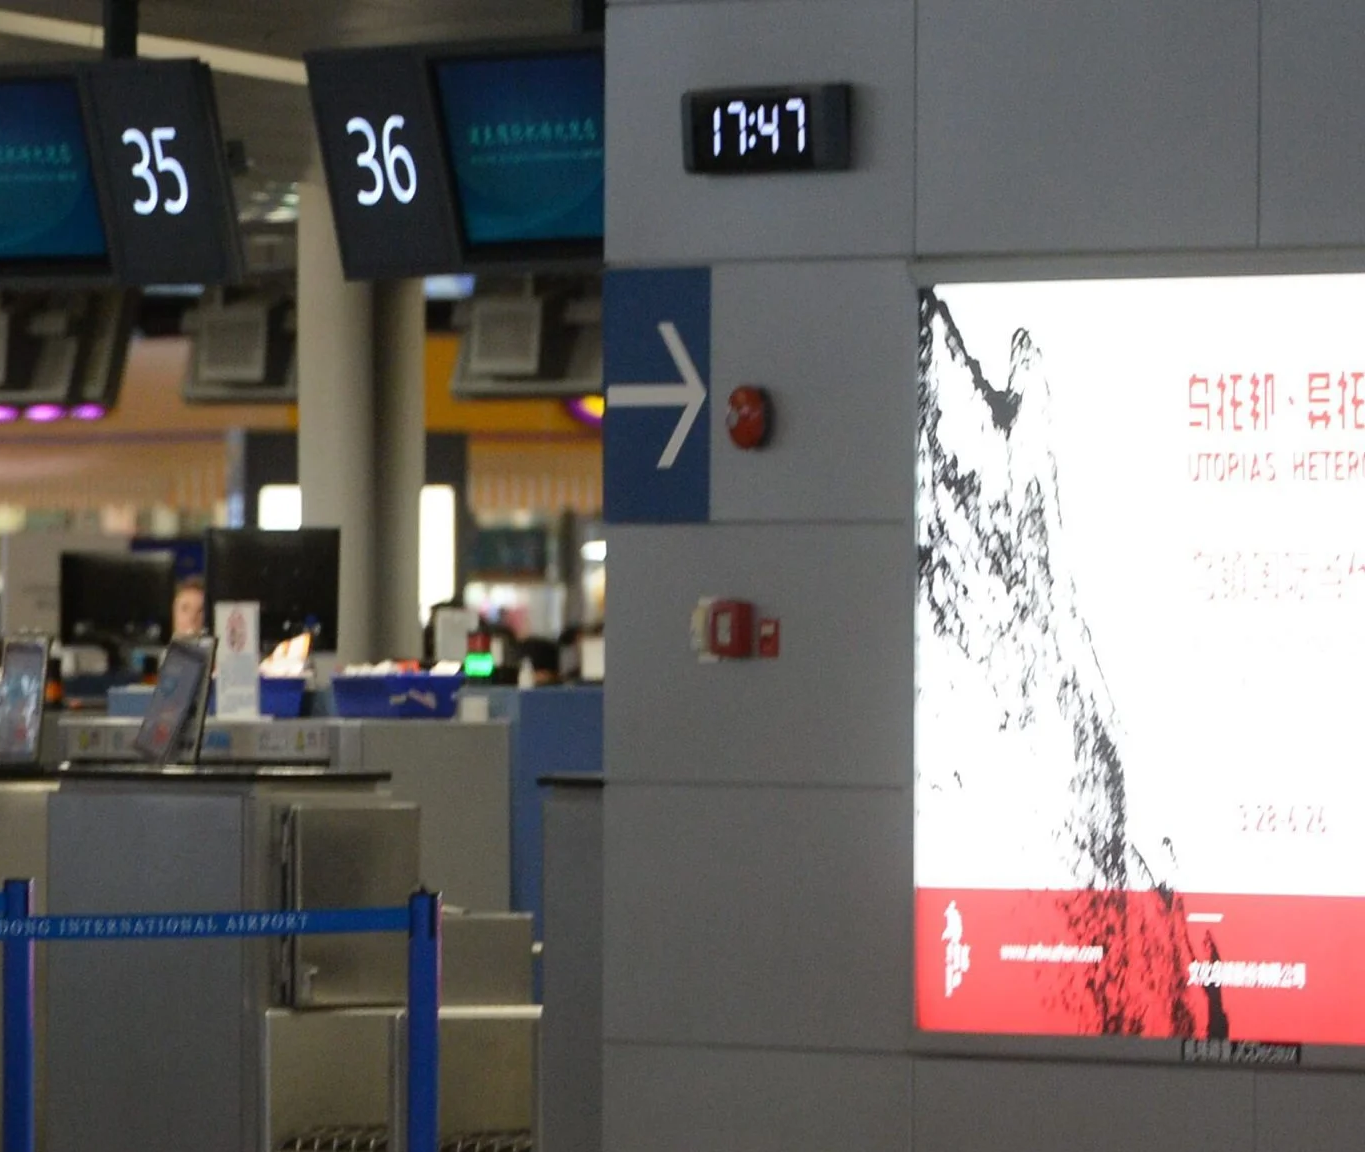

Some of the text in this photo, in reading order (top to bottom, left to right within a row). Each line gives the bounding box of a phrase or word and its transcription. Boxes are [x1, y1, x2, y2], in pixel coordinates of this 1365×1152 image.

[714, 98, 806, 156] 17:47
[121, 126, 189, 215] 35
[346, 115, 417, 206] 36
[1188, 450, 1365, 482] UTOPIAS HETER
[59, 915, 219, 936] INTERNATIONAL
[225, 912, 311, 932] AIRPORT
